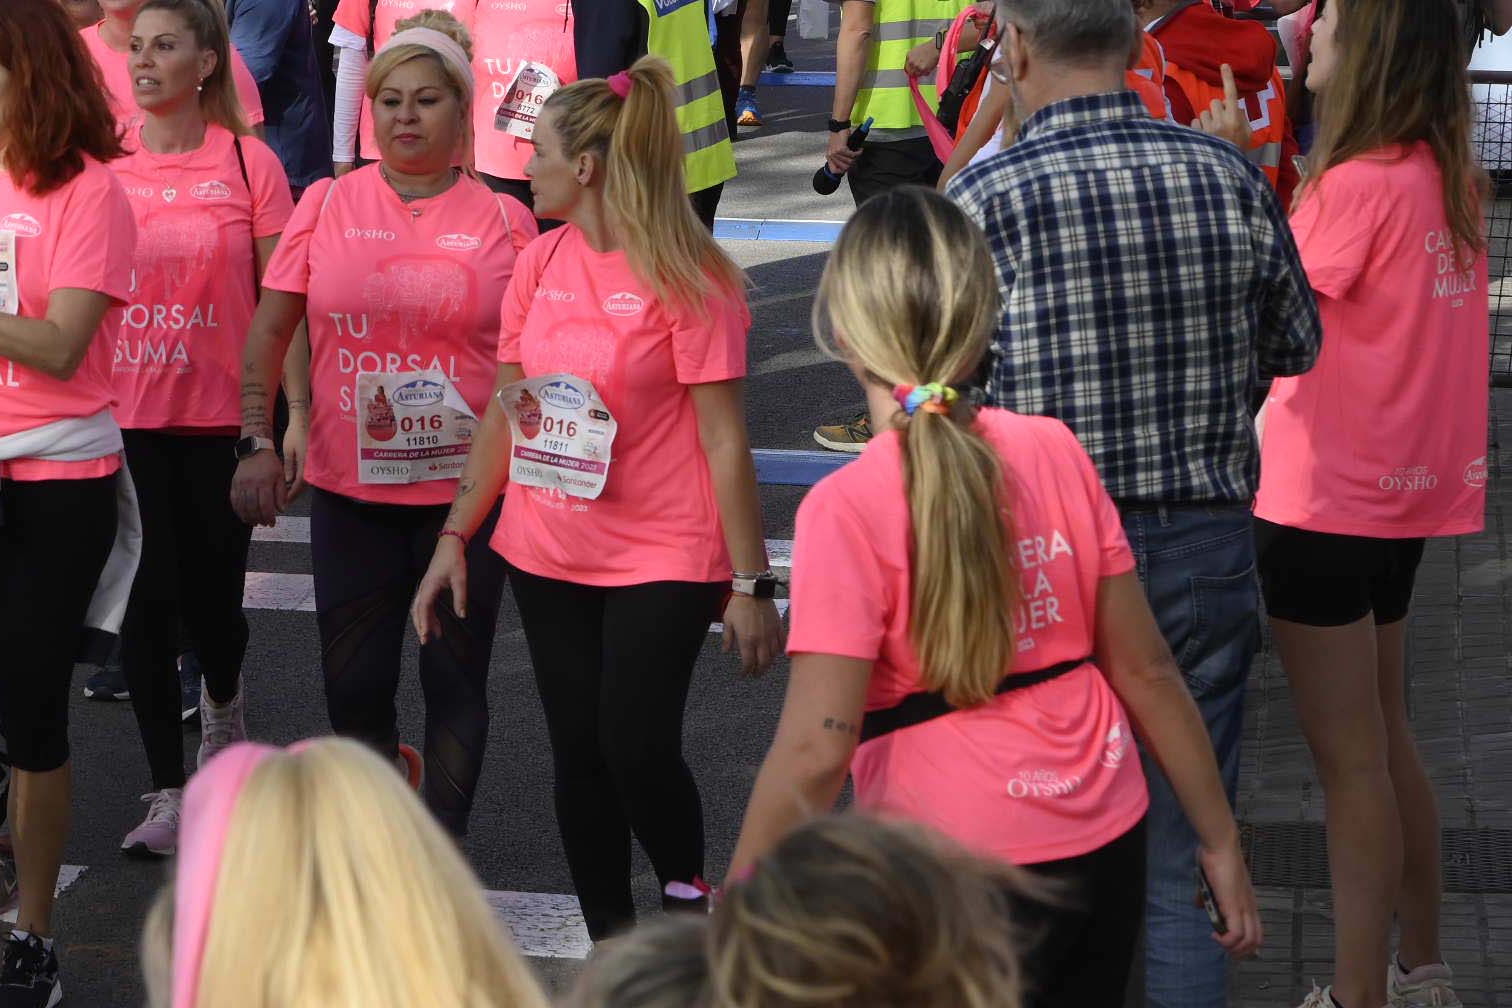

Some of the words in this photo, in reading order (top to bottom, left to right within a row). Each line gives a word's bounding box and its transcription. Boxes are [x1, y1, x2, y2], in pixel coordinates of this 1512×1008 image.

[484, 57, 513, 75] TU
[515, 89, 544, 105] 016
[344, 227, 396, 241] OYSHO
[329, 312, 368, 338] TU
[338, 347, 461, 383] DORSAL
[400, 414, 443, 433] 016
[542, 416, 578, 437] 016
[405, 435, 439, 447] 11810
[543, 439, 569, 453] 11811
[370, 465, 409, 476] OYSHO
[1378, 474, 1438, 491] OYSHO
